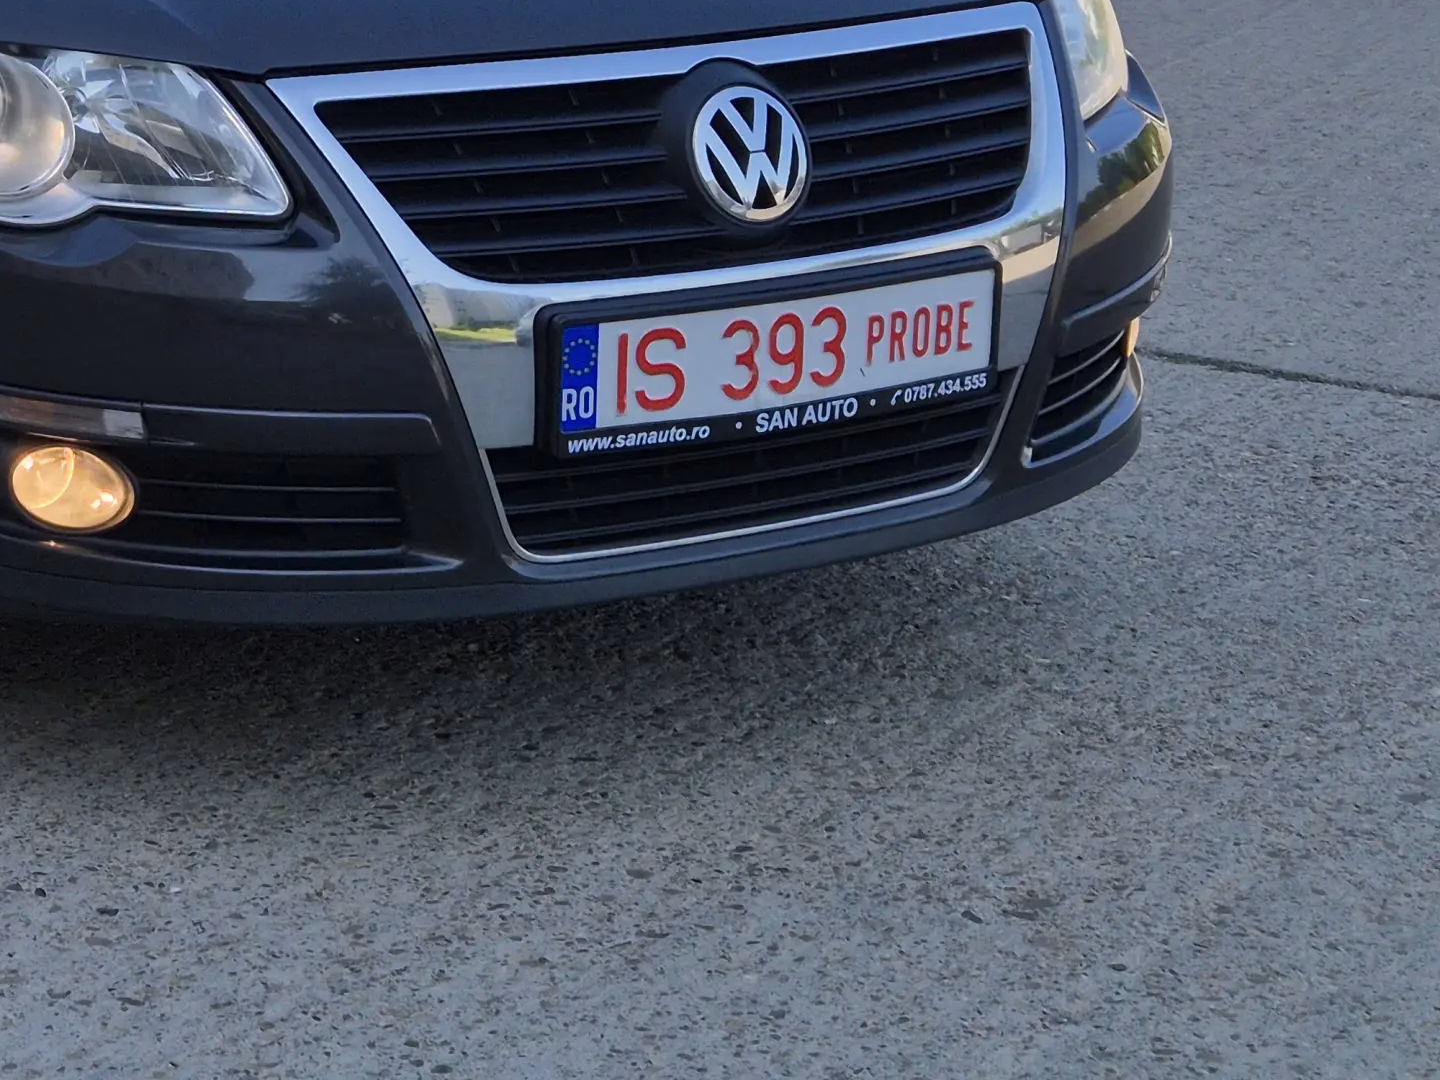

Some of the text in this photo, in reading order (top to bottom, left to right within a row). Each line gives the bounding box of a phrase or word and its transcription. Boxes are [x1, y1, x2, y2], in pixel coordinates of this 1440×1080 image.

[616, 299, 975, 415] IS 393 PROBE
[561, 386, 595, 422] RO
[568, 373, 987, 454] www.sanauto.ro SAN AUTO 0787.434.555
